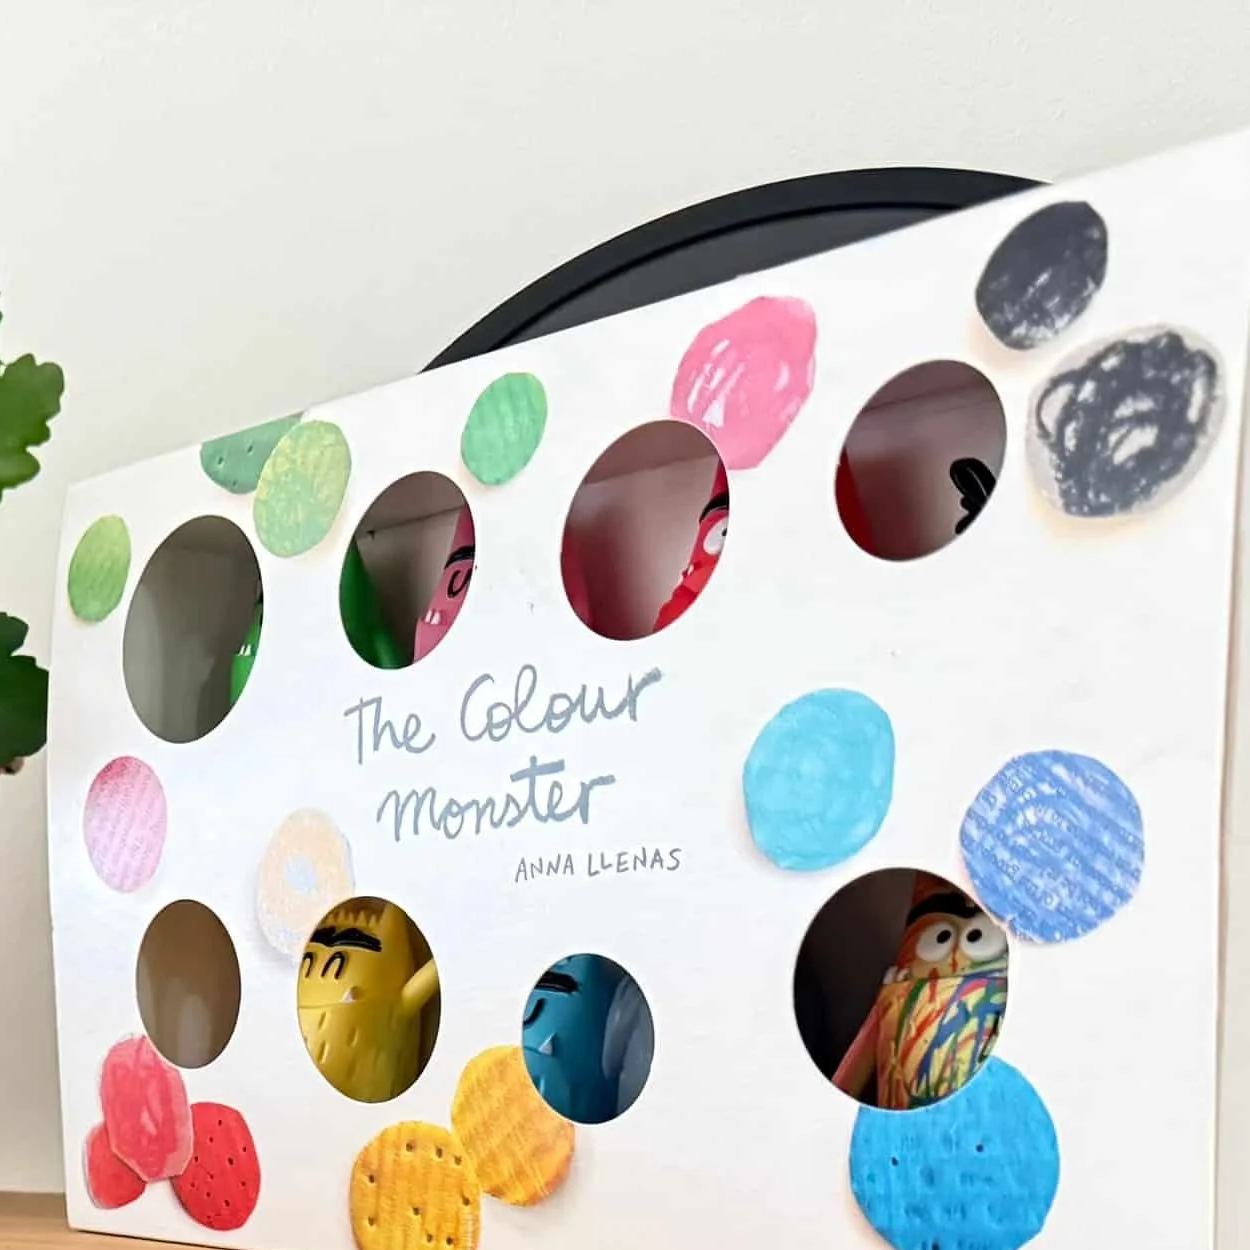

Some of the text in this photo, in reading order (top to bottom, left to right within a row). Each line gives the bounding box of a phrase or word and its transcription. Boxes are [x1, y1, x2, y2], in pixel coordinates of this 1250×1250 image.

[344, 664, 662, 764] The Colour
[514, 846, 682, 883] ANNA LLENAS
